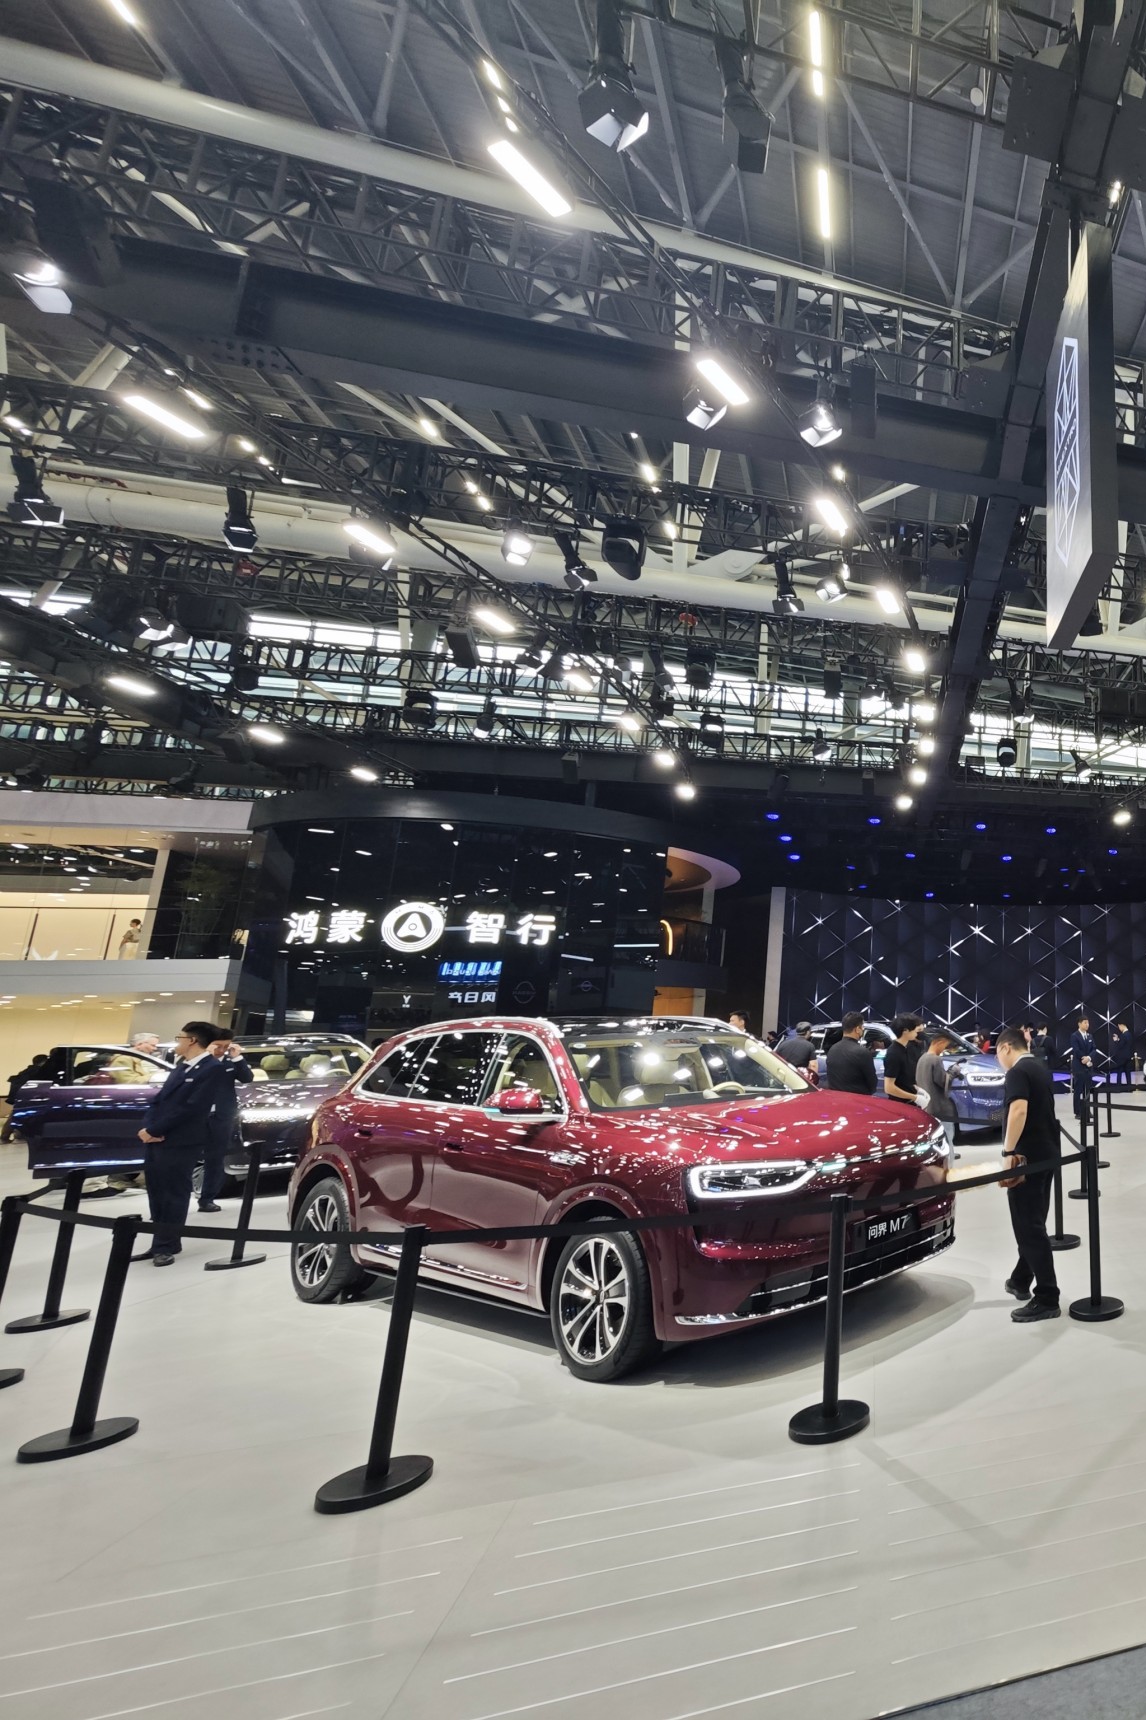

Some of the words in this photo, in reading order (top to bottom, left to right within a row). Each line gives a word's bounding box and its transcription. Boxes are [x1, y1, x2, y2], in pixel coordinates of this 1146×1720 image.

[284, 909, 367, 945] 鸿蒙
[466, 911, 557, 946] 智行
[868, 1221, 888, 1240] 问界
[889, 1214, 911, 1233] M7
